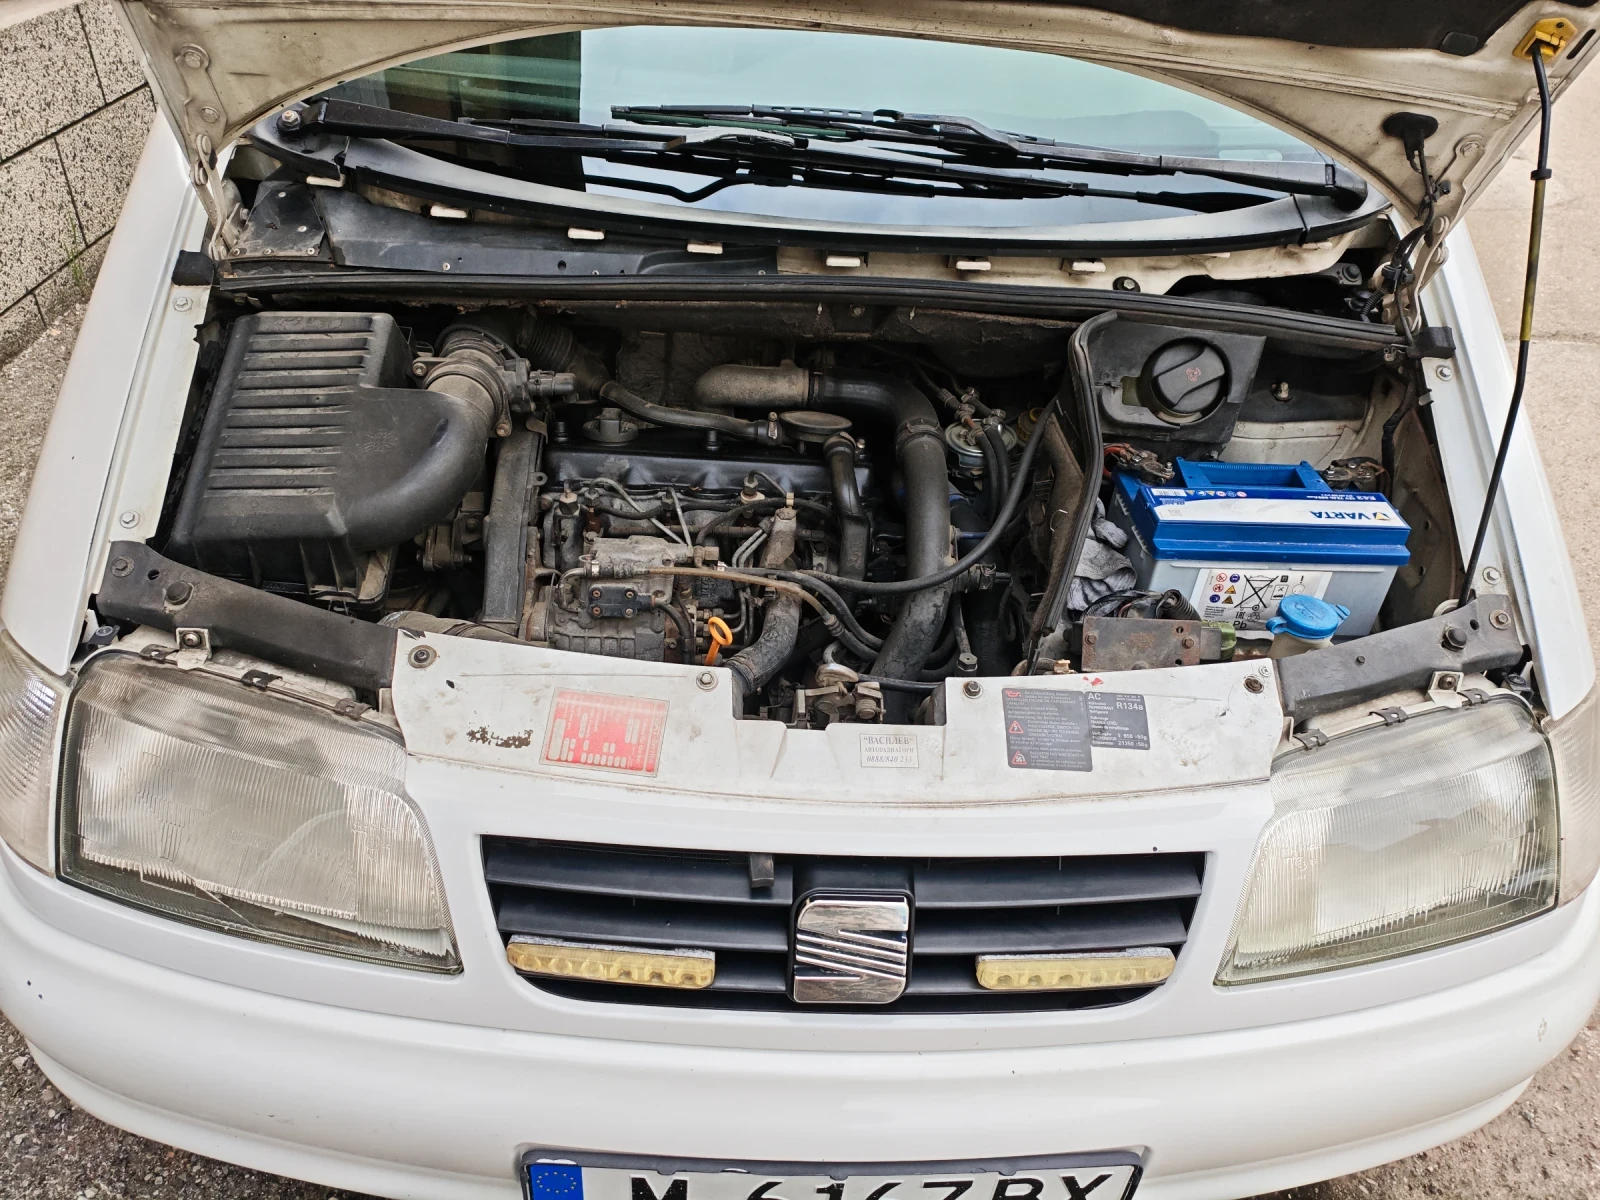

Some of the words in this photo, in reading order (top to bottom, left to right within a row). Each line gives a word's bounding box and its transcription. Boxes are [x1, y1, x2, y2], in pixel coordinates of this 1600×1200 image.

[1310, 511, 1372, 520] VARTA
[1233, 620, 1247, 629] Pb
[1088, 692, 1101, 700] AC
[1116, 701, 1144, 710] R134a
